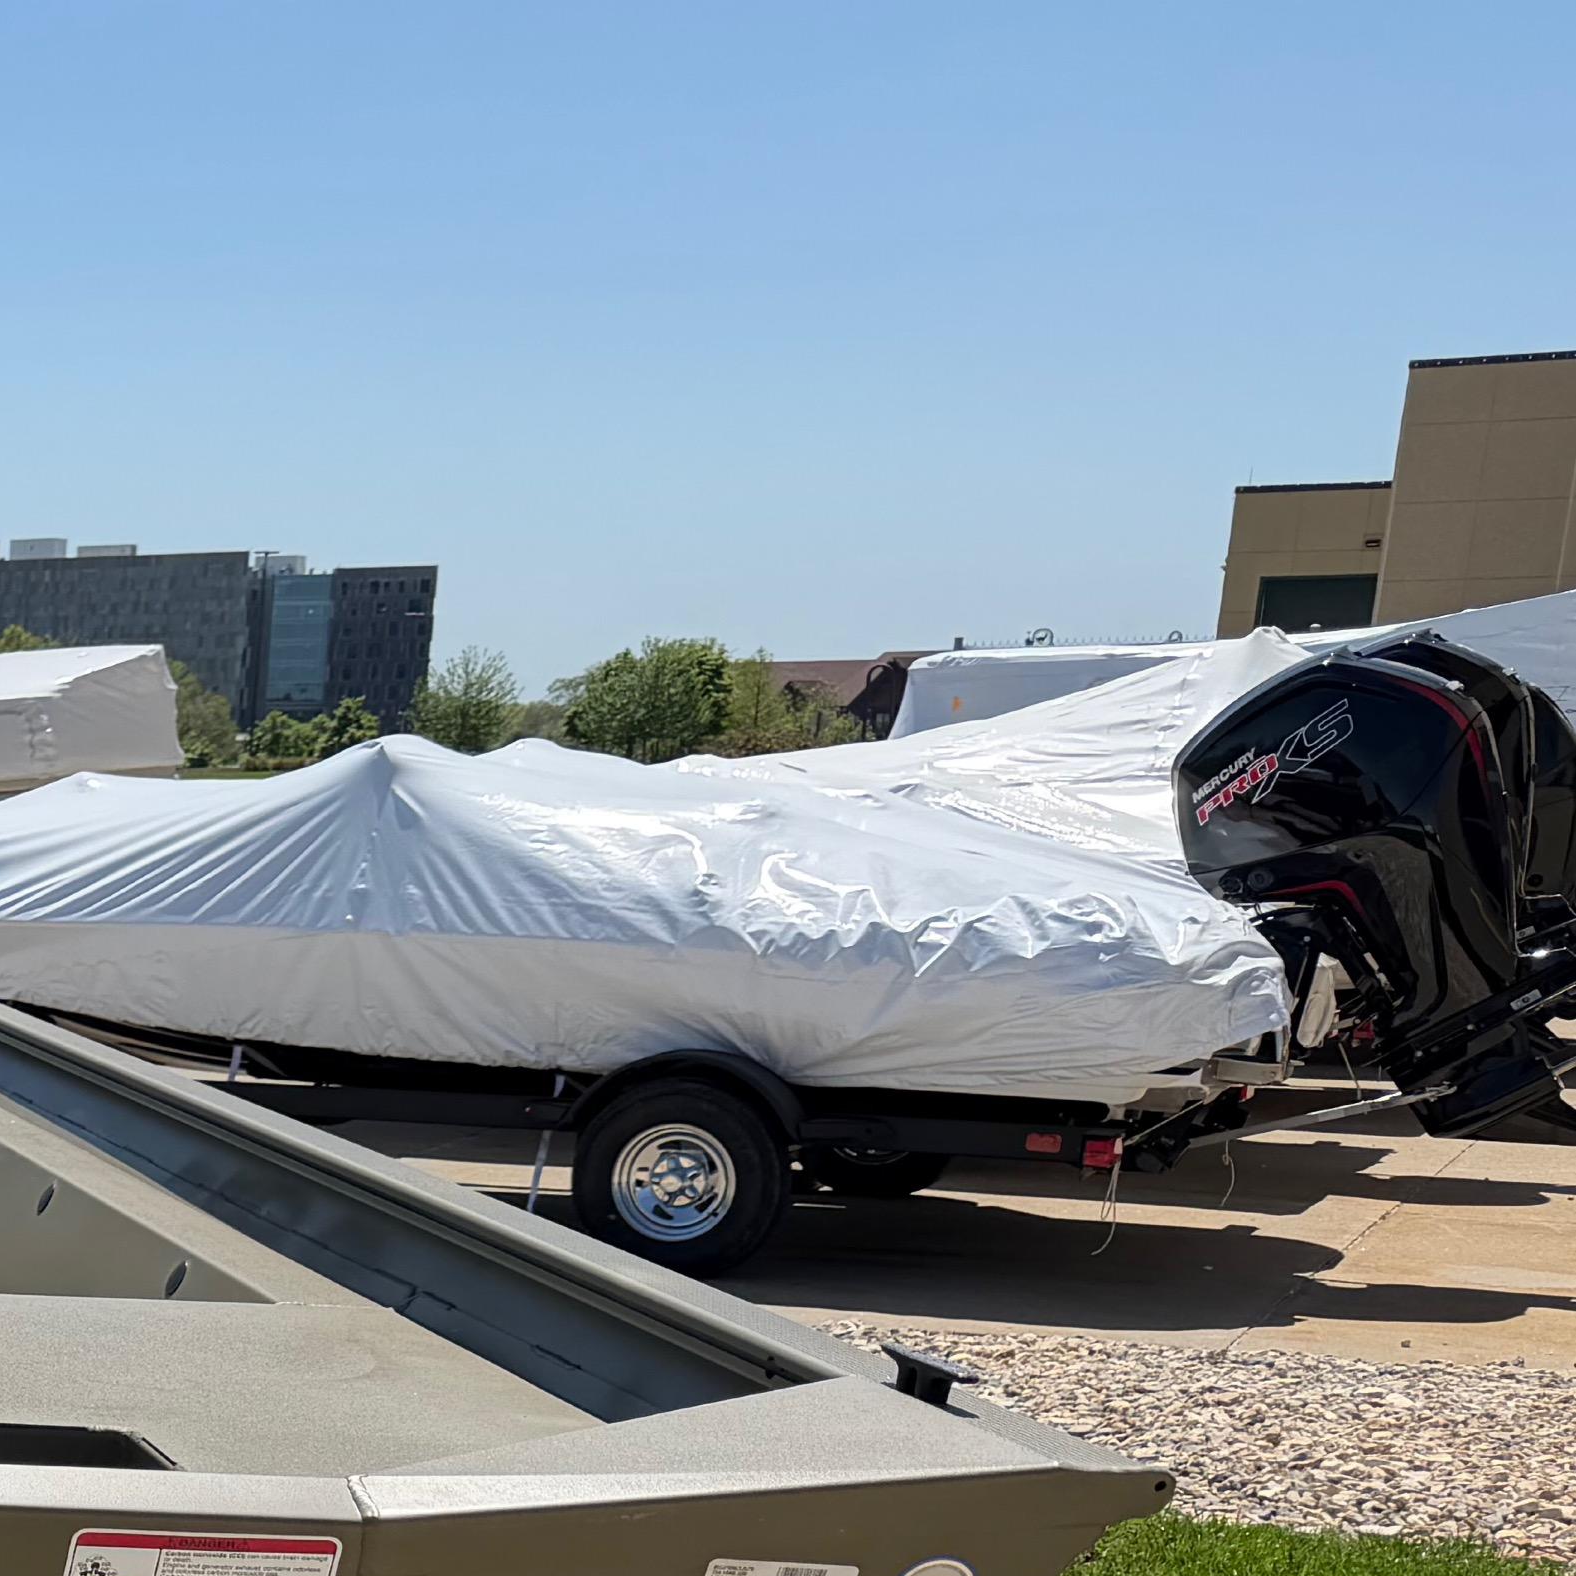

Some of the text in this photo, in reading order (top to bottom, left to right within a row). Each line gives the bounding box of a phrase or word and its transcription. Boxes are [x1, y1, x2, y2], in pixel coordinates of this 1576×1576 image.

[1192, 747, 1256, 803] MERCURY
[1196, 698, 1354, 826] PRO XS
